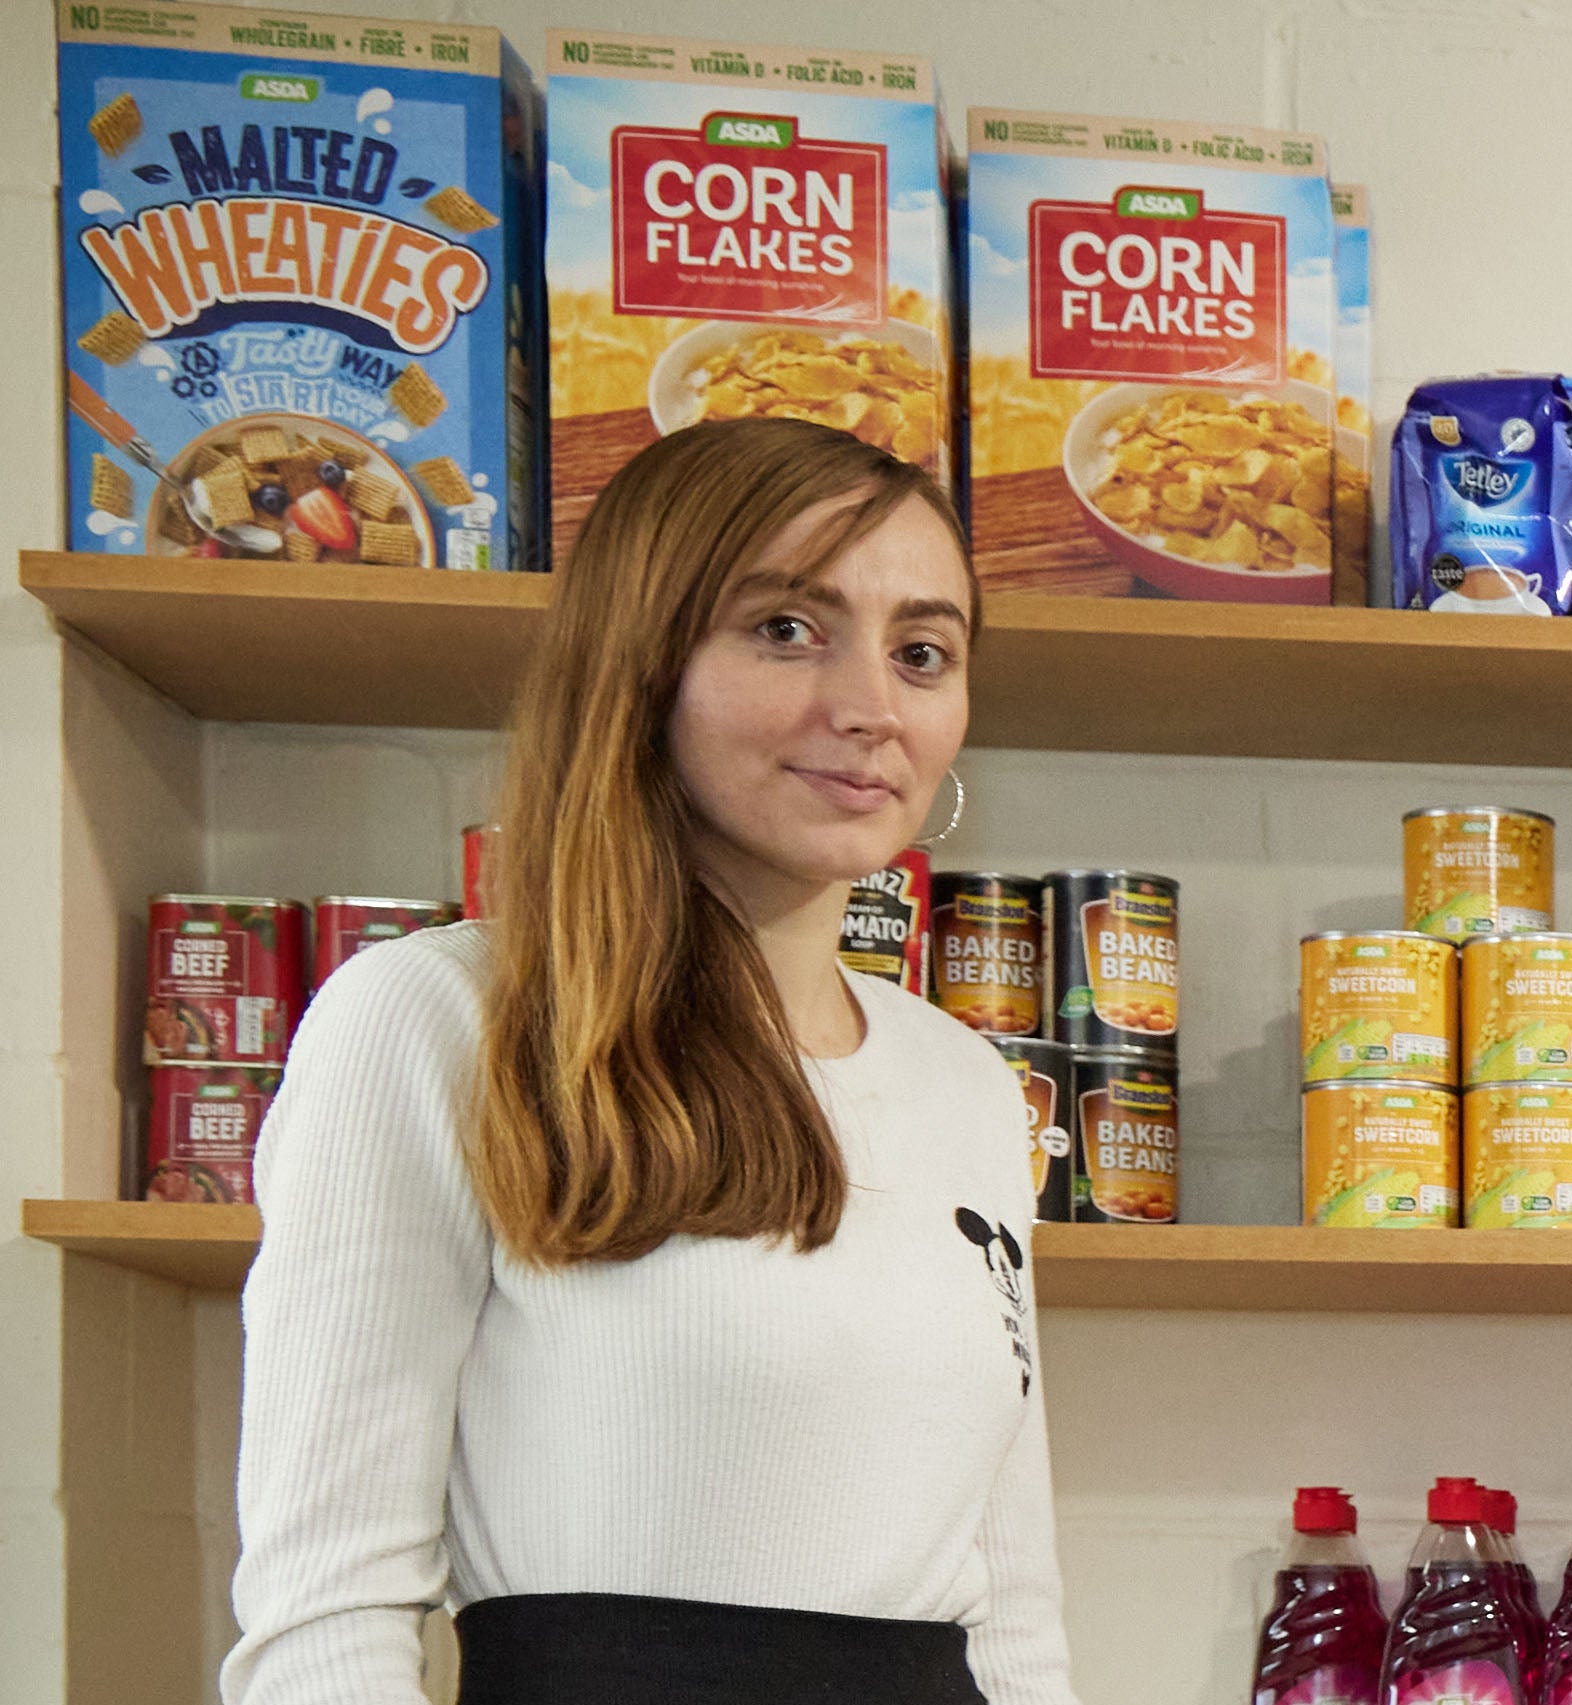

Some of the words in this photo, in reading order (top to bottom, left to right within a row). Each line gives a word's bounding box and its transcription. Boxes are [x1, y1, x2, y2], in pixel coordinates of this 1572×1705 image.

[71, 6, 99, 30] NO
[563, 41, 589, 63] NO
[691, 56, 750, 78] VITAMIN
[254, 79, 309, 100] ASDA
[719, 120, 781, 145] ASDA
[984, 121, 1008, 141] NO
[168, 124, 398, 206] MALTED
[644, 159, 855, 231] CORN
[1129, 194, 1187, 216] ASDA
[646, 222, 853, 278] FLAKES
[1059, 231, 1255, 297] CORN
[84, 200, 488, 350] WHEATIES
[1061, 290, 1255, 340] FLAKES
[1453, 460, 1519, 500] Tetley
[945, 934, 1036, 963] BAKED
[1099, 931, 1177, 961] BAKED
[171, 952, 230, 977] BEEF
[946, 961, 1034, 988] BEANS
[1101, 957, 1177, 987] BEANS
[1328, 977, 1416, 994] SWEETCORN
[189, 1117, 246, 1140] BEEF
[1097, 1120, 1176, 1149] BAKED
[1354, 1127, 1440, 1146] SWEETCORN
[1099, 1145, 1176, 1174] BEANS
